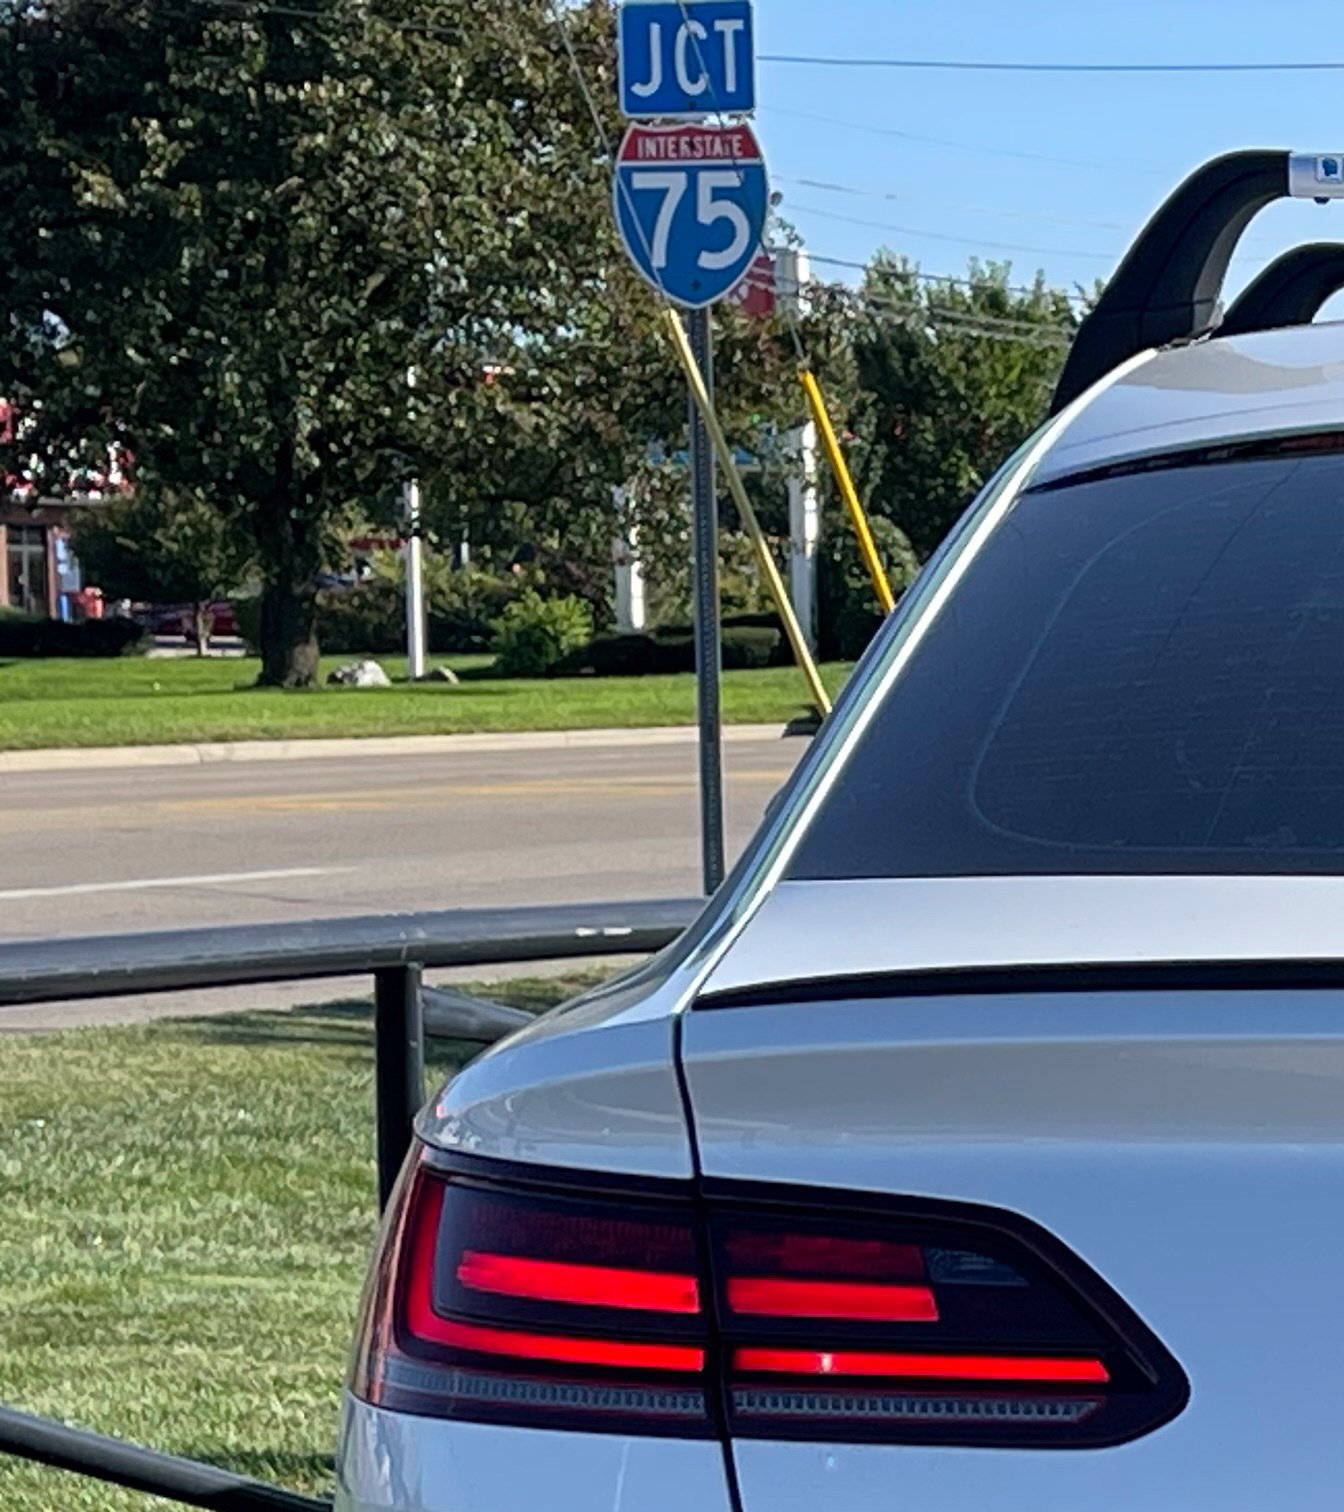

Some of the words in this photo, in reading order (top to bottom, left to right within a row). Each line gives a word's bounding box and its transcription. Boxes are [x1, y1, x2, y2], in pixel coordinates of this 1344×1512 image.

[630, 18, 744, 97] JCT
[637, 134, 744, 159] INTERSTATE
[631, 171, 751, 270] 75
